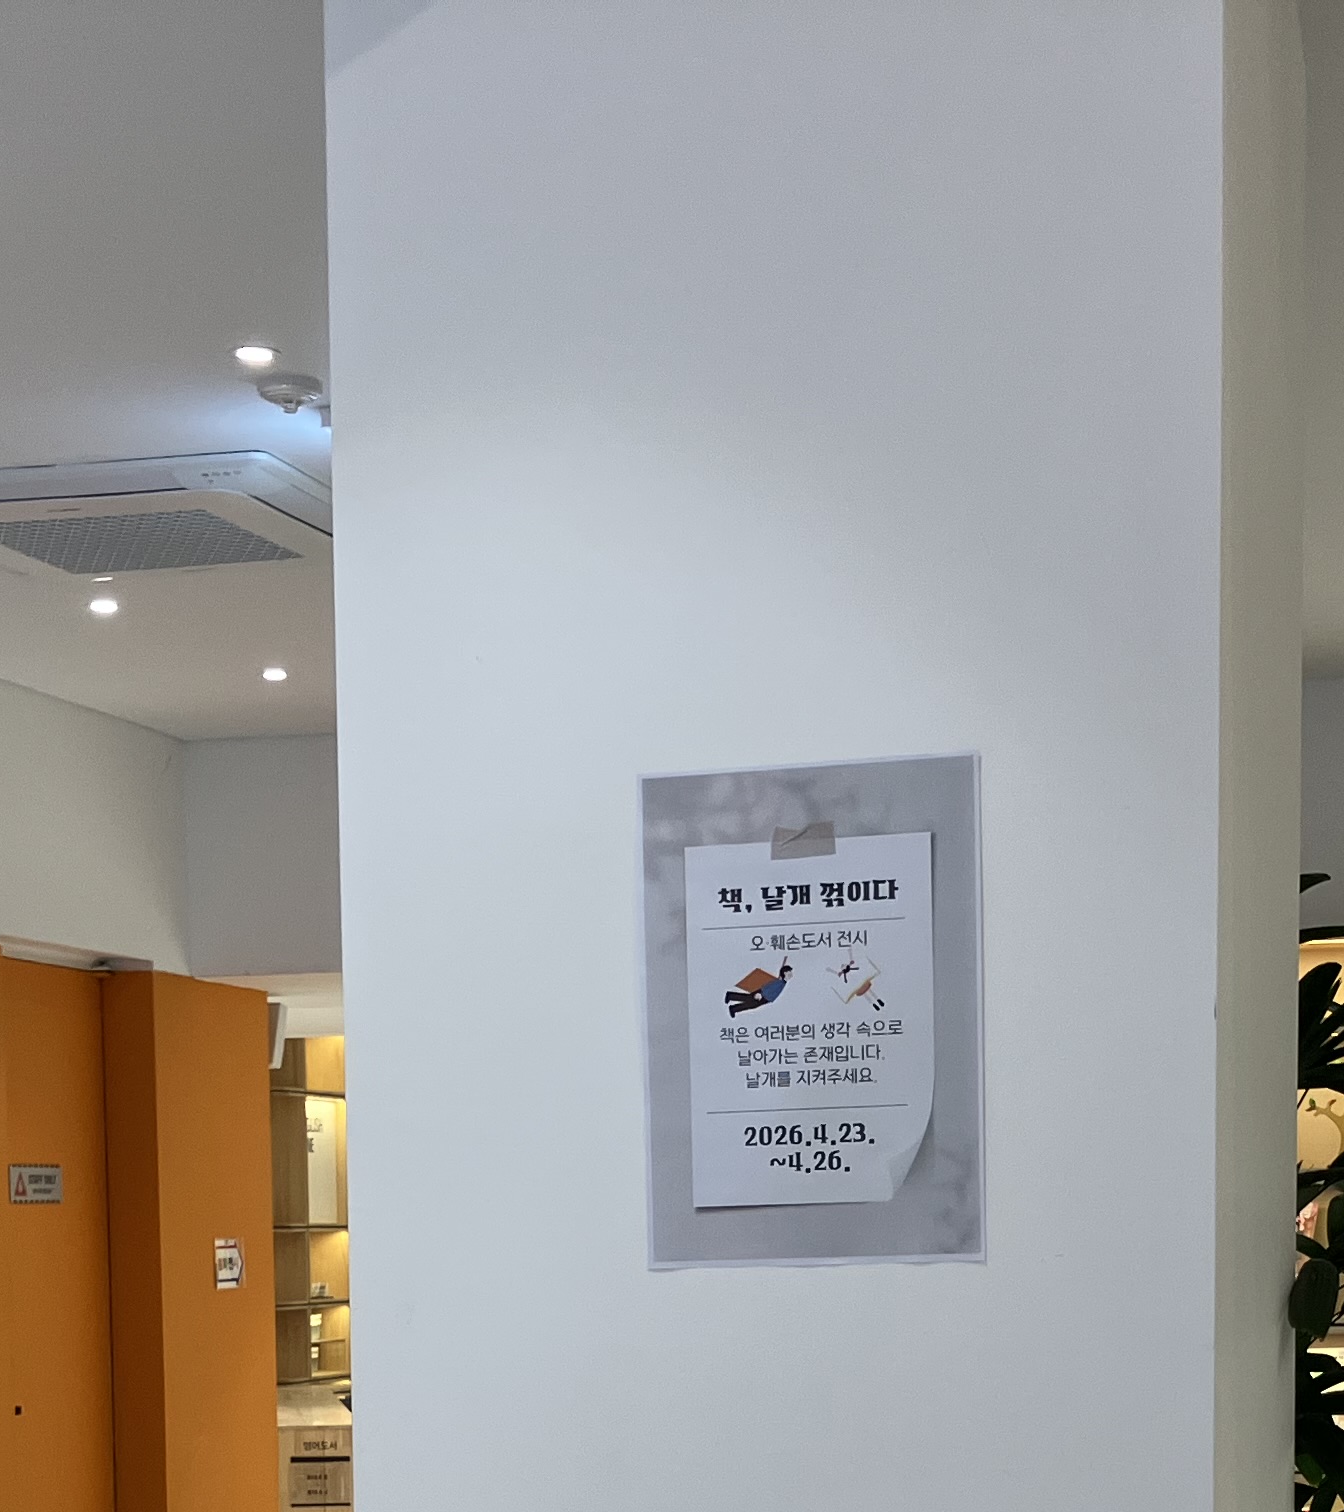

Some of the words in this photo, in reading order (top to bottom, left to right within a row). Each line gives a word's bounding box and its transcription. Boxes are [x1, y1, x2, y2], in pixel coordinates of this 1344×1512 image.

[718, 888, 753, 913] 책,
[760, 884, 811, 911] 날개
[820, 879, 899, 908] 꺾이다
[837, 929, 868, 948] 전시
[719, 1027, 750, 1044] 책은
[755, 1024, 816, 1042] 여러분의
[821, 1022, 851, 1039] 생각
[856, 1020, 904, 1037] 속으로
[738, 1048, 798, 1067] 날아가는
[803, 1044, 886, 1064] 존재입니다.
[746, 1071, 791, 1088] 날개를
[796, 1067, 878, 1086] 지켜주세요.
[744, 1122, 876, 1147] 2026.4.23.
[769, 1150, 851, 1174] ~4.26.
